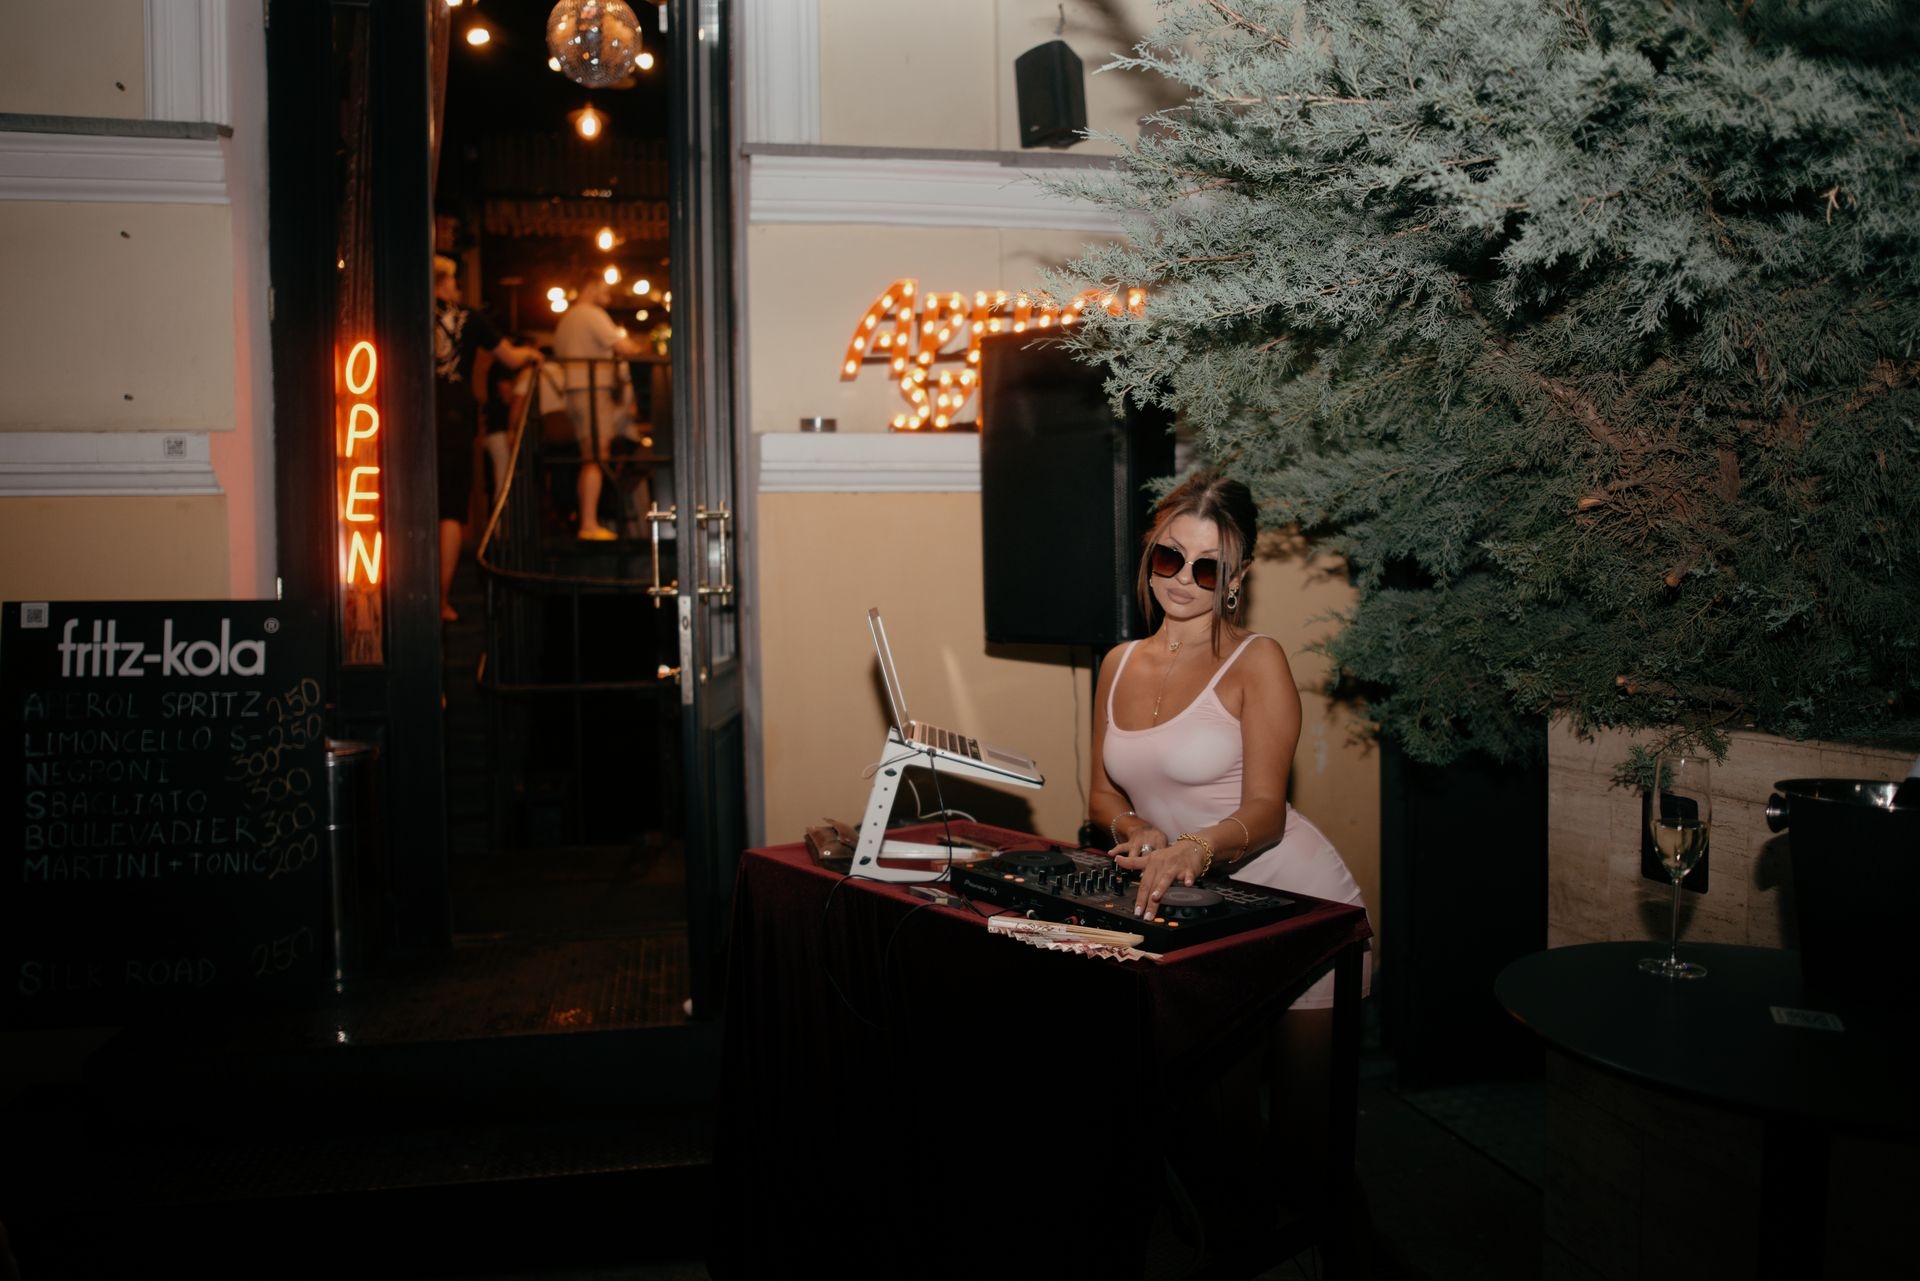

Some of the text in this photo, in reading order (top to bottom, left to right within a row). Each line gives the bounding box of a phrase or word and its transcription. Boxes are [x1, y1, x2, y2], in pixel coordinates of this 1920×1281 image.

[345, 341, 382, 584] OPEN
[24, 677, 320, 723] APEROL SPRITZ 250
[25, 725, 212, 757] LIMONCELLO
[268, 713, 321, 752] 250
[25, 758, 170, 785] NEGRONI
[25, 802, 316, 850] BOULEVADIER 300
[16, 959, 104, 996] SILK
[124, 957, 217, 987] ROAD
